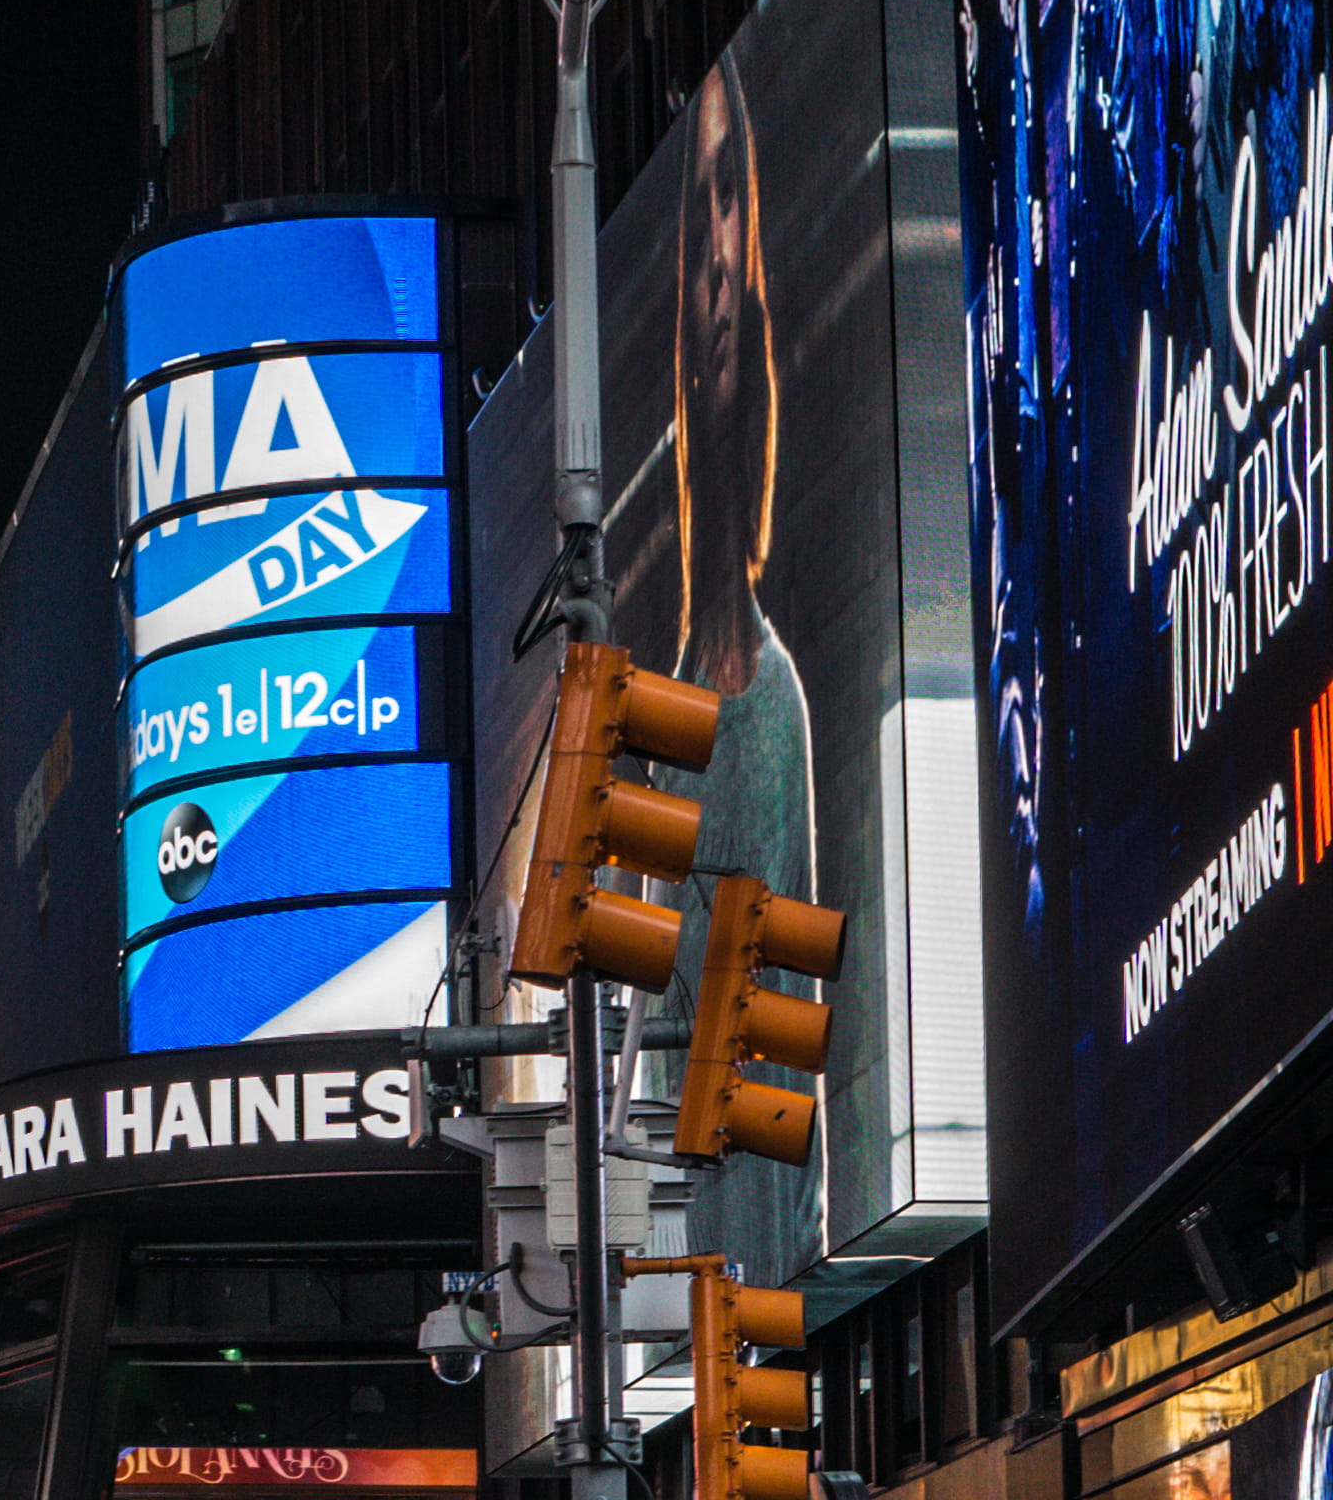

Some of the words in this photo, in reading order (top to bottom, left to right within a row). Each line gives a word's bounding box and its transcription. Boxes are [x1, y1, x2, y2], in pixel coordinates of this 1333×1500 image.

[247, 485, 381, 610] DAY
[1128, 309, 1219, 594] Adam
[1166, 484, 1236, 762] 100%
[1239, 344, 1329, 674] FRESH
[157, 826, 219, 875] abc
[1124, 916, 1170, 1045] NOW
[1170, 782, 1287, 992] STREAMING
[104, 1069, 412, 1158] HAINES
